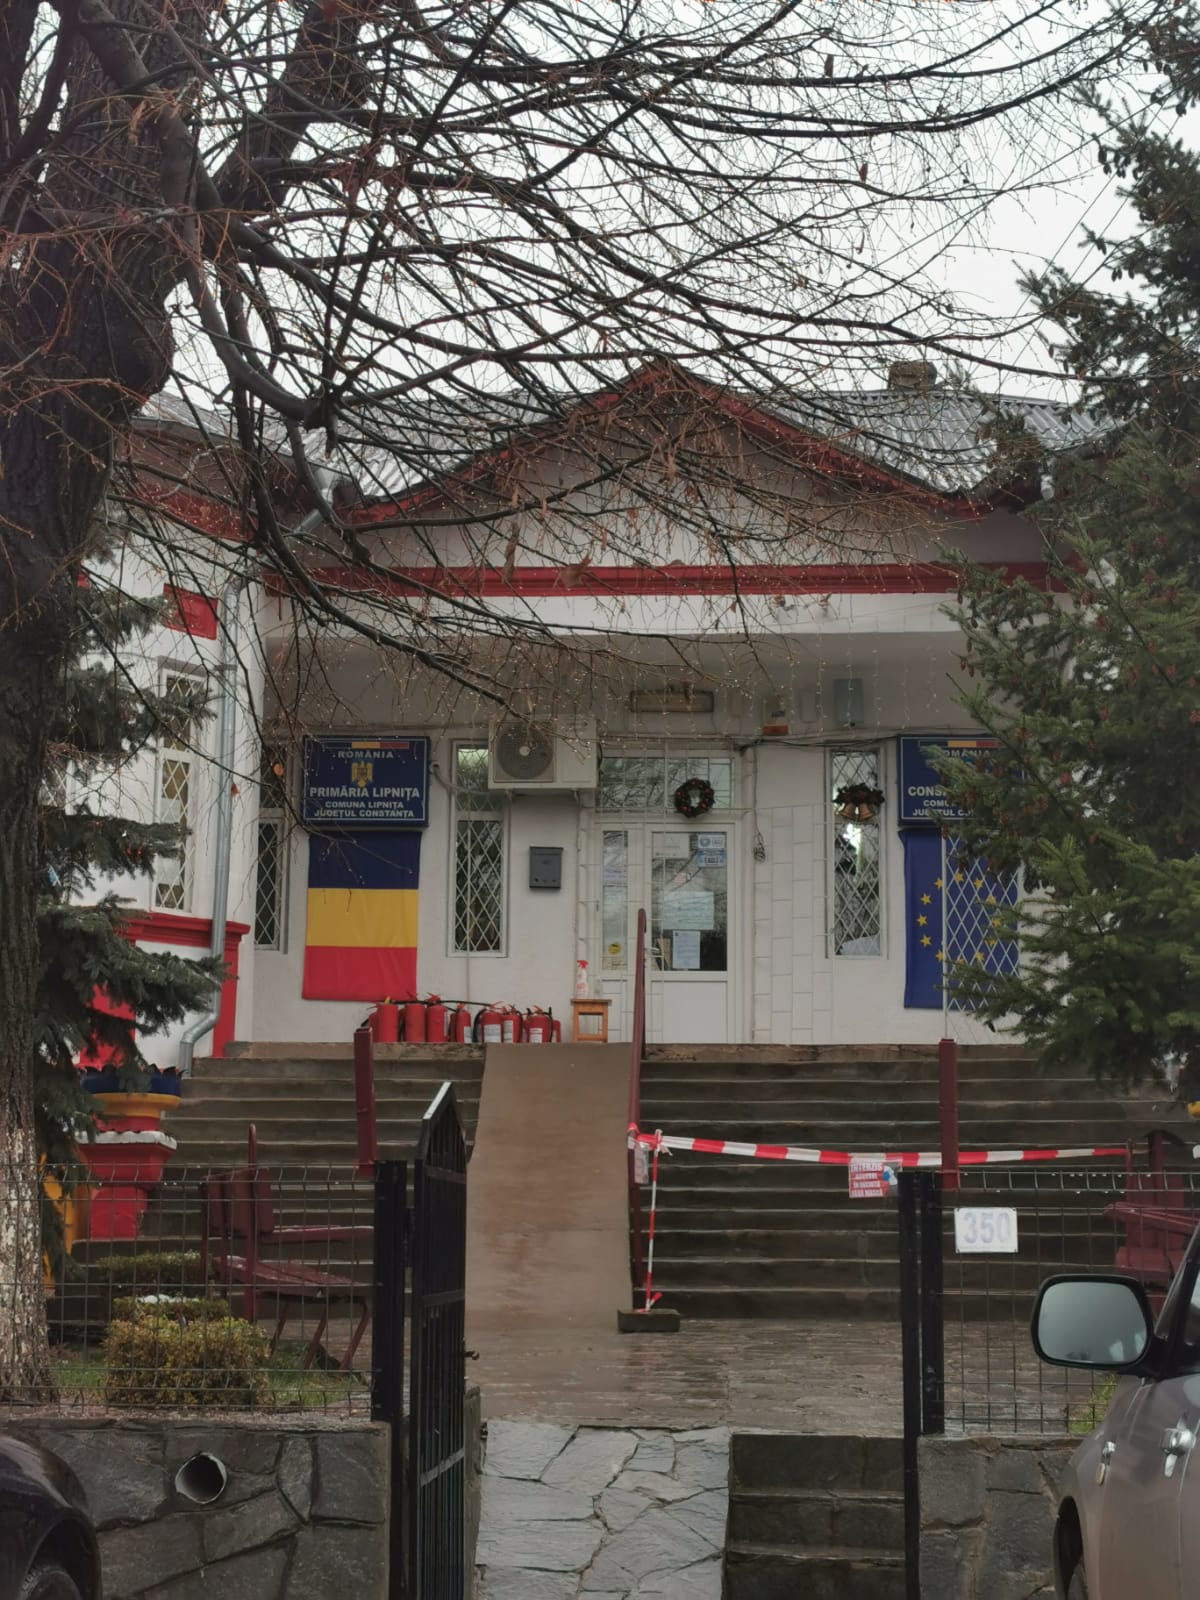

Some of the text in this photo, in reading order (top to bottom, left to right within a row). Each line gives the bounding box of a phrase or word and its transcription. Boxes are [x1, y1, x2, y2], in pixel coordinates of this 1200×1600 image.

[337, 749, 394, 759] ROMÂNIA
[309, 785, 370, 798] PRIMĂRIA
[325, 801, 366, 809] COMUNA
[963, 1212, 1011, 1244] 350
